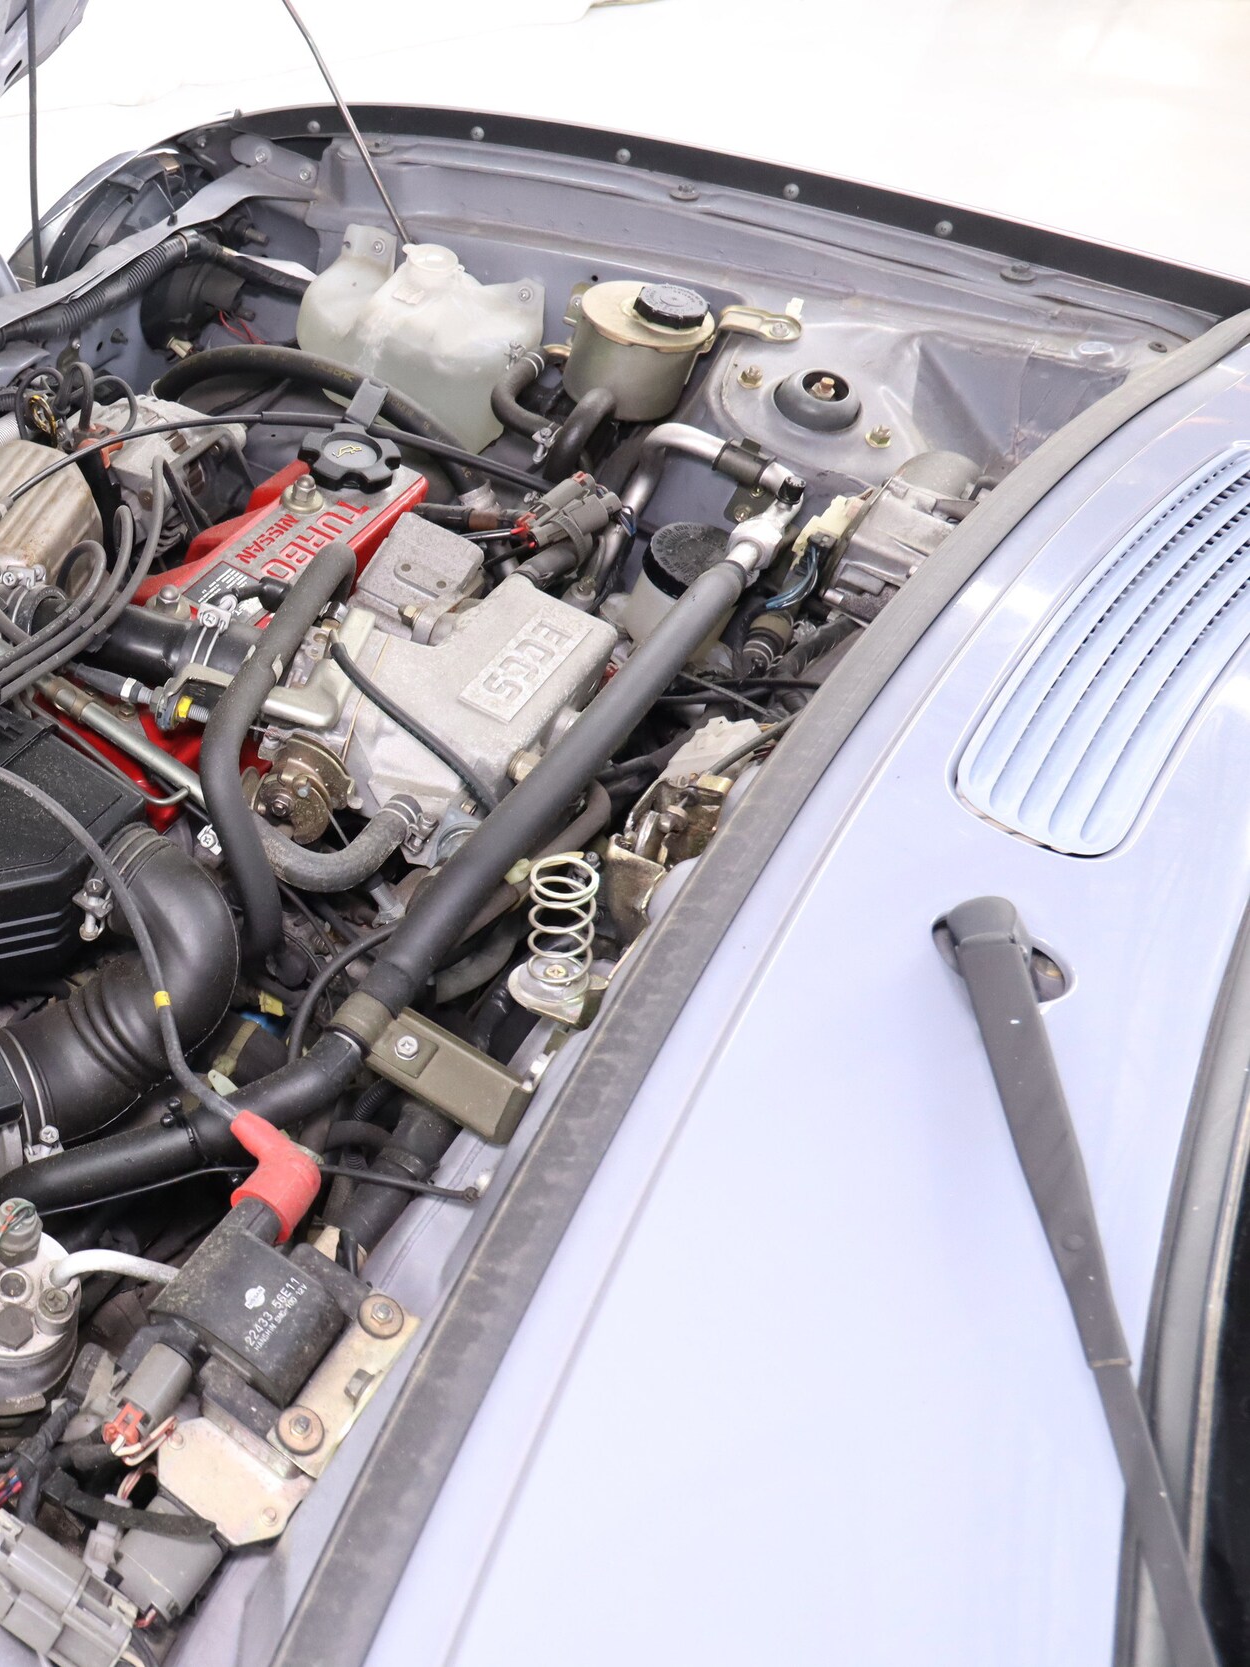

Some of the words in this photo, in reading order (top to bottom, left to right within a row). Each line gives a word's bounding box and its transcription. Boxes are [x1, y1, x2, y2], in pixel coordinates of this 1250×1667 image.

[235, 513, 299, 565] NISSAN
[261, 499, 369, 580] TURBO
[482, 621, 575, 701] ECCS
[244, 1311, 272, 1347] 22433
[272, 1277, 300, 1309] 56E11
